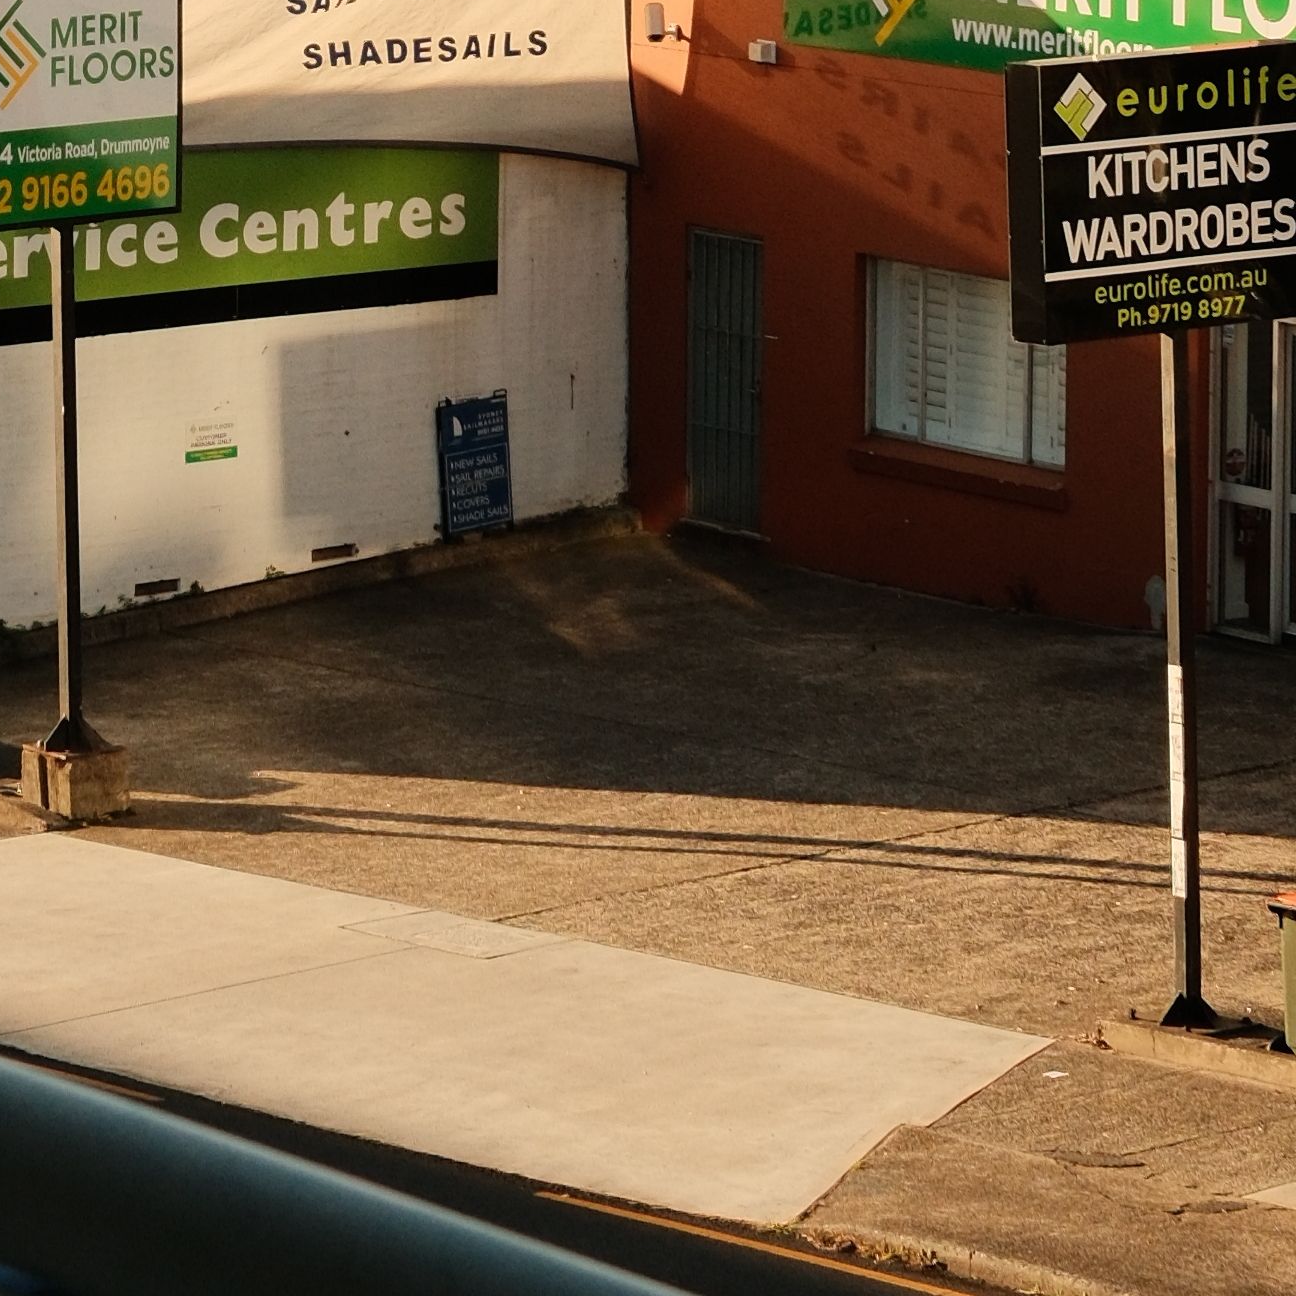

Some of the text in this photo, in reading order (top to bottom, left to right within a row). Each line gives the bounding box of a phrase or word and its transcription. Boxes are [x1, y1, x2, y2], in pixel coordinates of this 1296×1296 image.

[50, 11, 143, 49] MERIT
[952, 18, 1153, 58] www.meritfloo
[50, 45, 175, 88] FLOORS
[303, 29, 548, 70] SHADESAILS
[1116, 65, 1296, 118] eurolife
[17, 143, 62, 164] Victoria
[65, 141, 98, 159] Road,
[101, 135, 171, 154] Drummoyne
[21, 171, 88, 212] 9166
[97, 163, 170, 203] 4696
[1087, 139, 1271, 199] KITCHENS
[199, 192, 466, 258] Centres
[1062, 197, 1296, 264] WARDROBES
[1094, 268, 1267, 305] eurolife.com.au
[1117, 294, 1246, 328] Ph.9719 8977
[455, 453, 498, 470] NEW SAILS
[455, 464, 505, 482] SAIL REPAIRS
[456, 482, 488, 497] RECUTS
[456, 496, 490, 510] COVERS
[457, 505, 509, 523] SHADE SAILS
